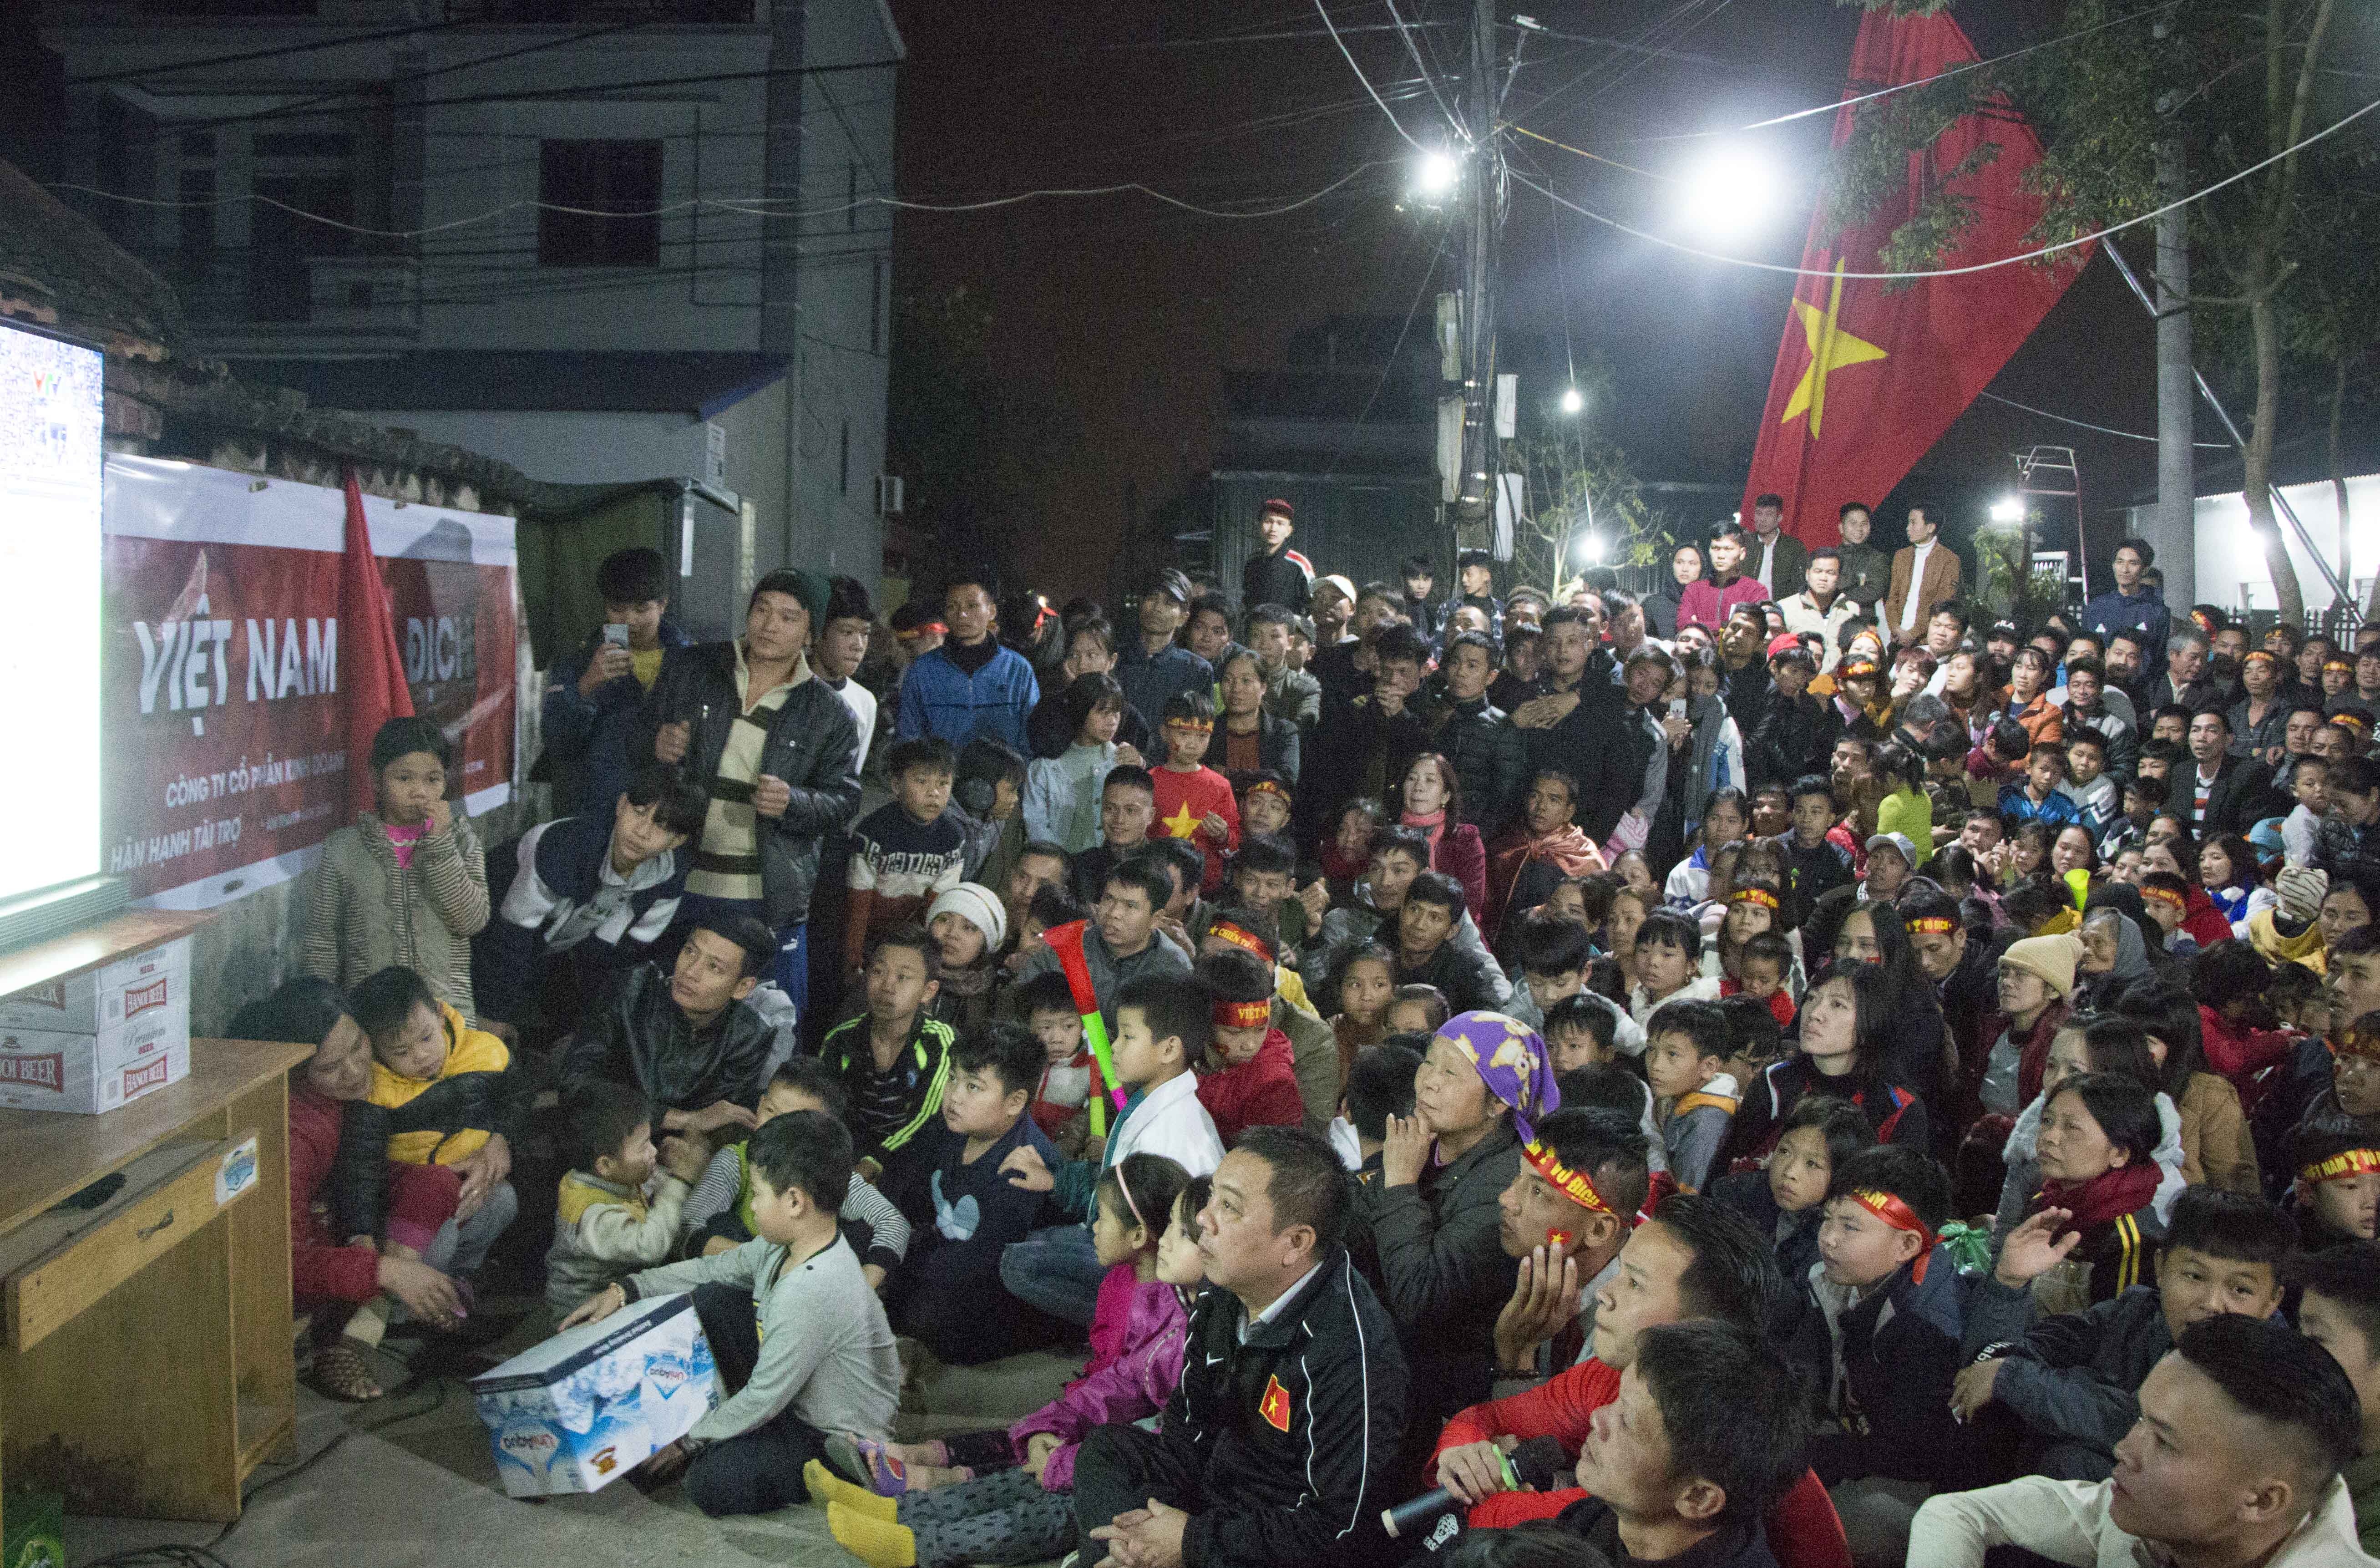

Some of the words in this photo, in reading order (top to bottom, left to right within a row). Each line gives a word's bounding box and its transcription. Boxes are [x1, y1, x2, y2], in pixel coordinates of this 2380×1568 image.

[134, 593, 233, 736] VIỆT
[247, 617, 337, 702] NAM
[166, 773, 209, 808] CÔNG
[211, 771, 226, 799] TY
[228, 755, 248, 794] CỔ
[148, 830, 191, 868] HẠNH
[216, 812, 243, 849] TRỢ
[20, 1058, 57, 1086] BEER
[649, 1367, 684, 1380] UniAqua
